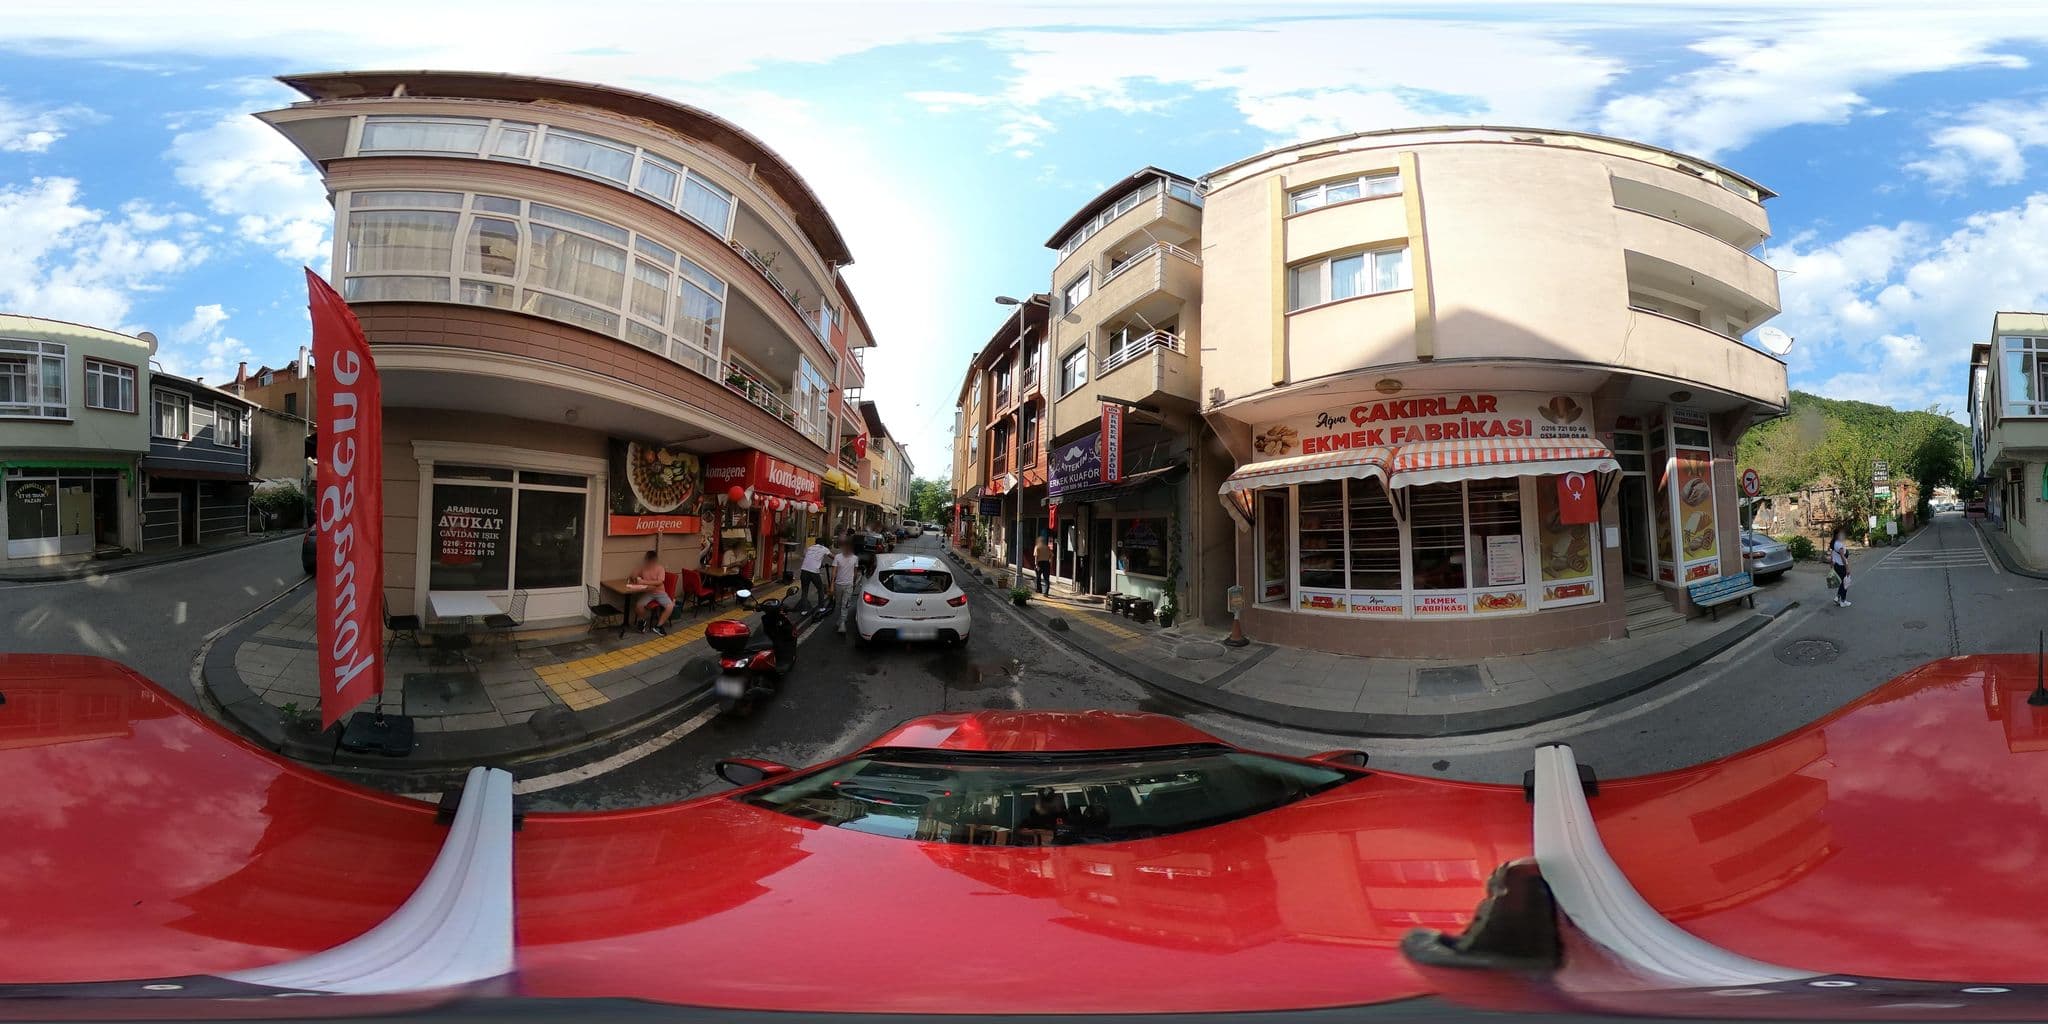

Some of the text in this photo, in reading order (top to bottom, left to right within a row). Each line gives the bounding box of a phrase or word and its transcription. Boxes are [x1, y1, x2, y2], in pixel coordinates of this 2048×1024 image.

[1349, 394, 1498, 427] ÇAKIRLAR
[1302, 418, 1532, 454] EKMEK FABRİKASI
[705, 464, 746, 482] komagene
[768, 459, 815, 496] komagene
[446, 505, 498, 515] ARABULUCU
[438, 515, 504, 530] AVUKAT
[636, 517, 682, 532] komagene
